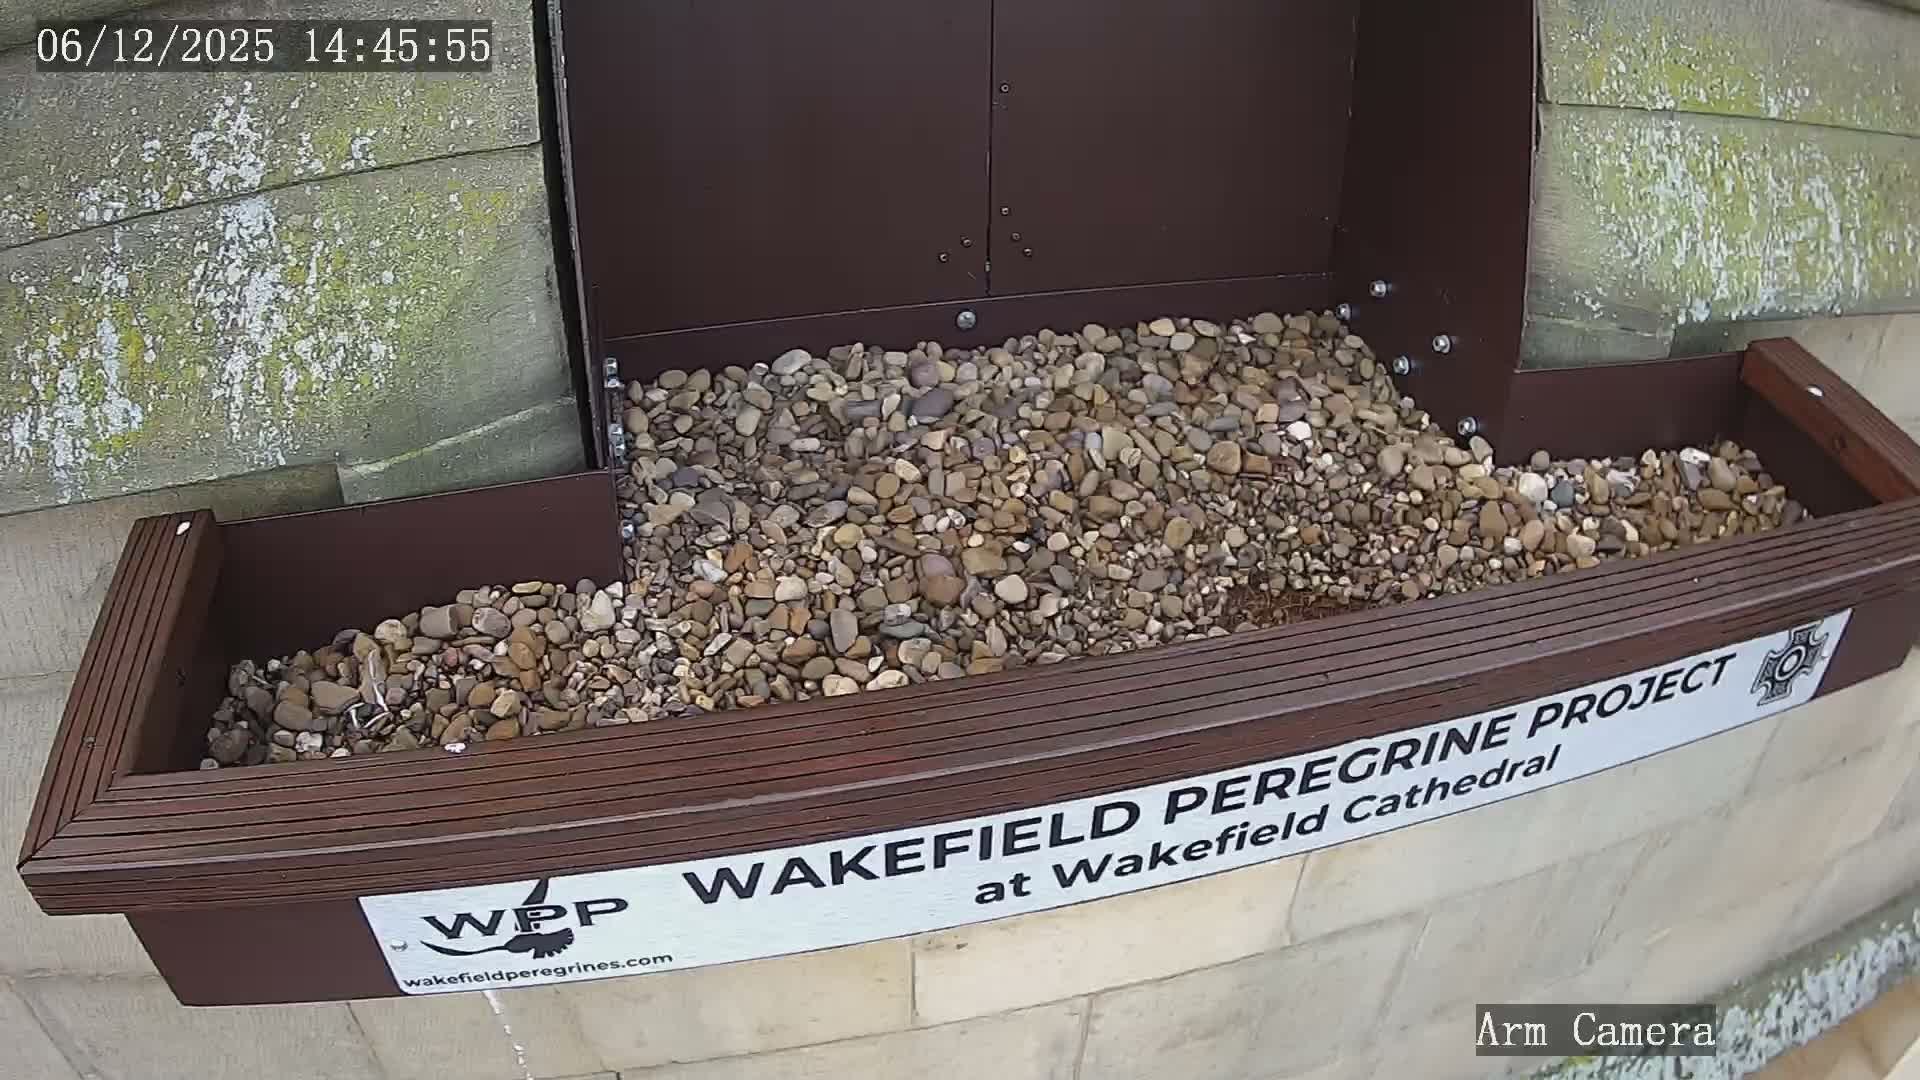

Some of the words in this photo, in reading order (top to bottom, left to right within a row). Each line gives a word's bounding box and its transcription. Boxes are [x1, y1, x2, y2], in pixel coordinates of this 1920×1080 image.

[682, 801, 1141, 905] WAKEFIELD
[1163, 713, 1517, 826] PEREGRINE
[1526, 653, 1737, 739] PROJECT
[974, 872, 1032, 905] at
[1051, 806, 1327, 889] Wakefield
[1342, 745, 1561, 825] Cathedral
[420, 897, 629, 940] WPP
[402, 951, 674, 989] wakefieldperegrines.com
